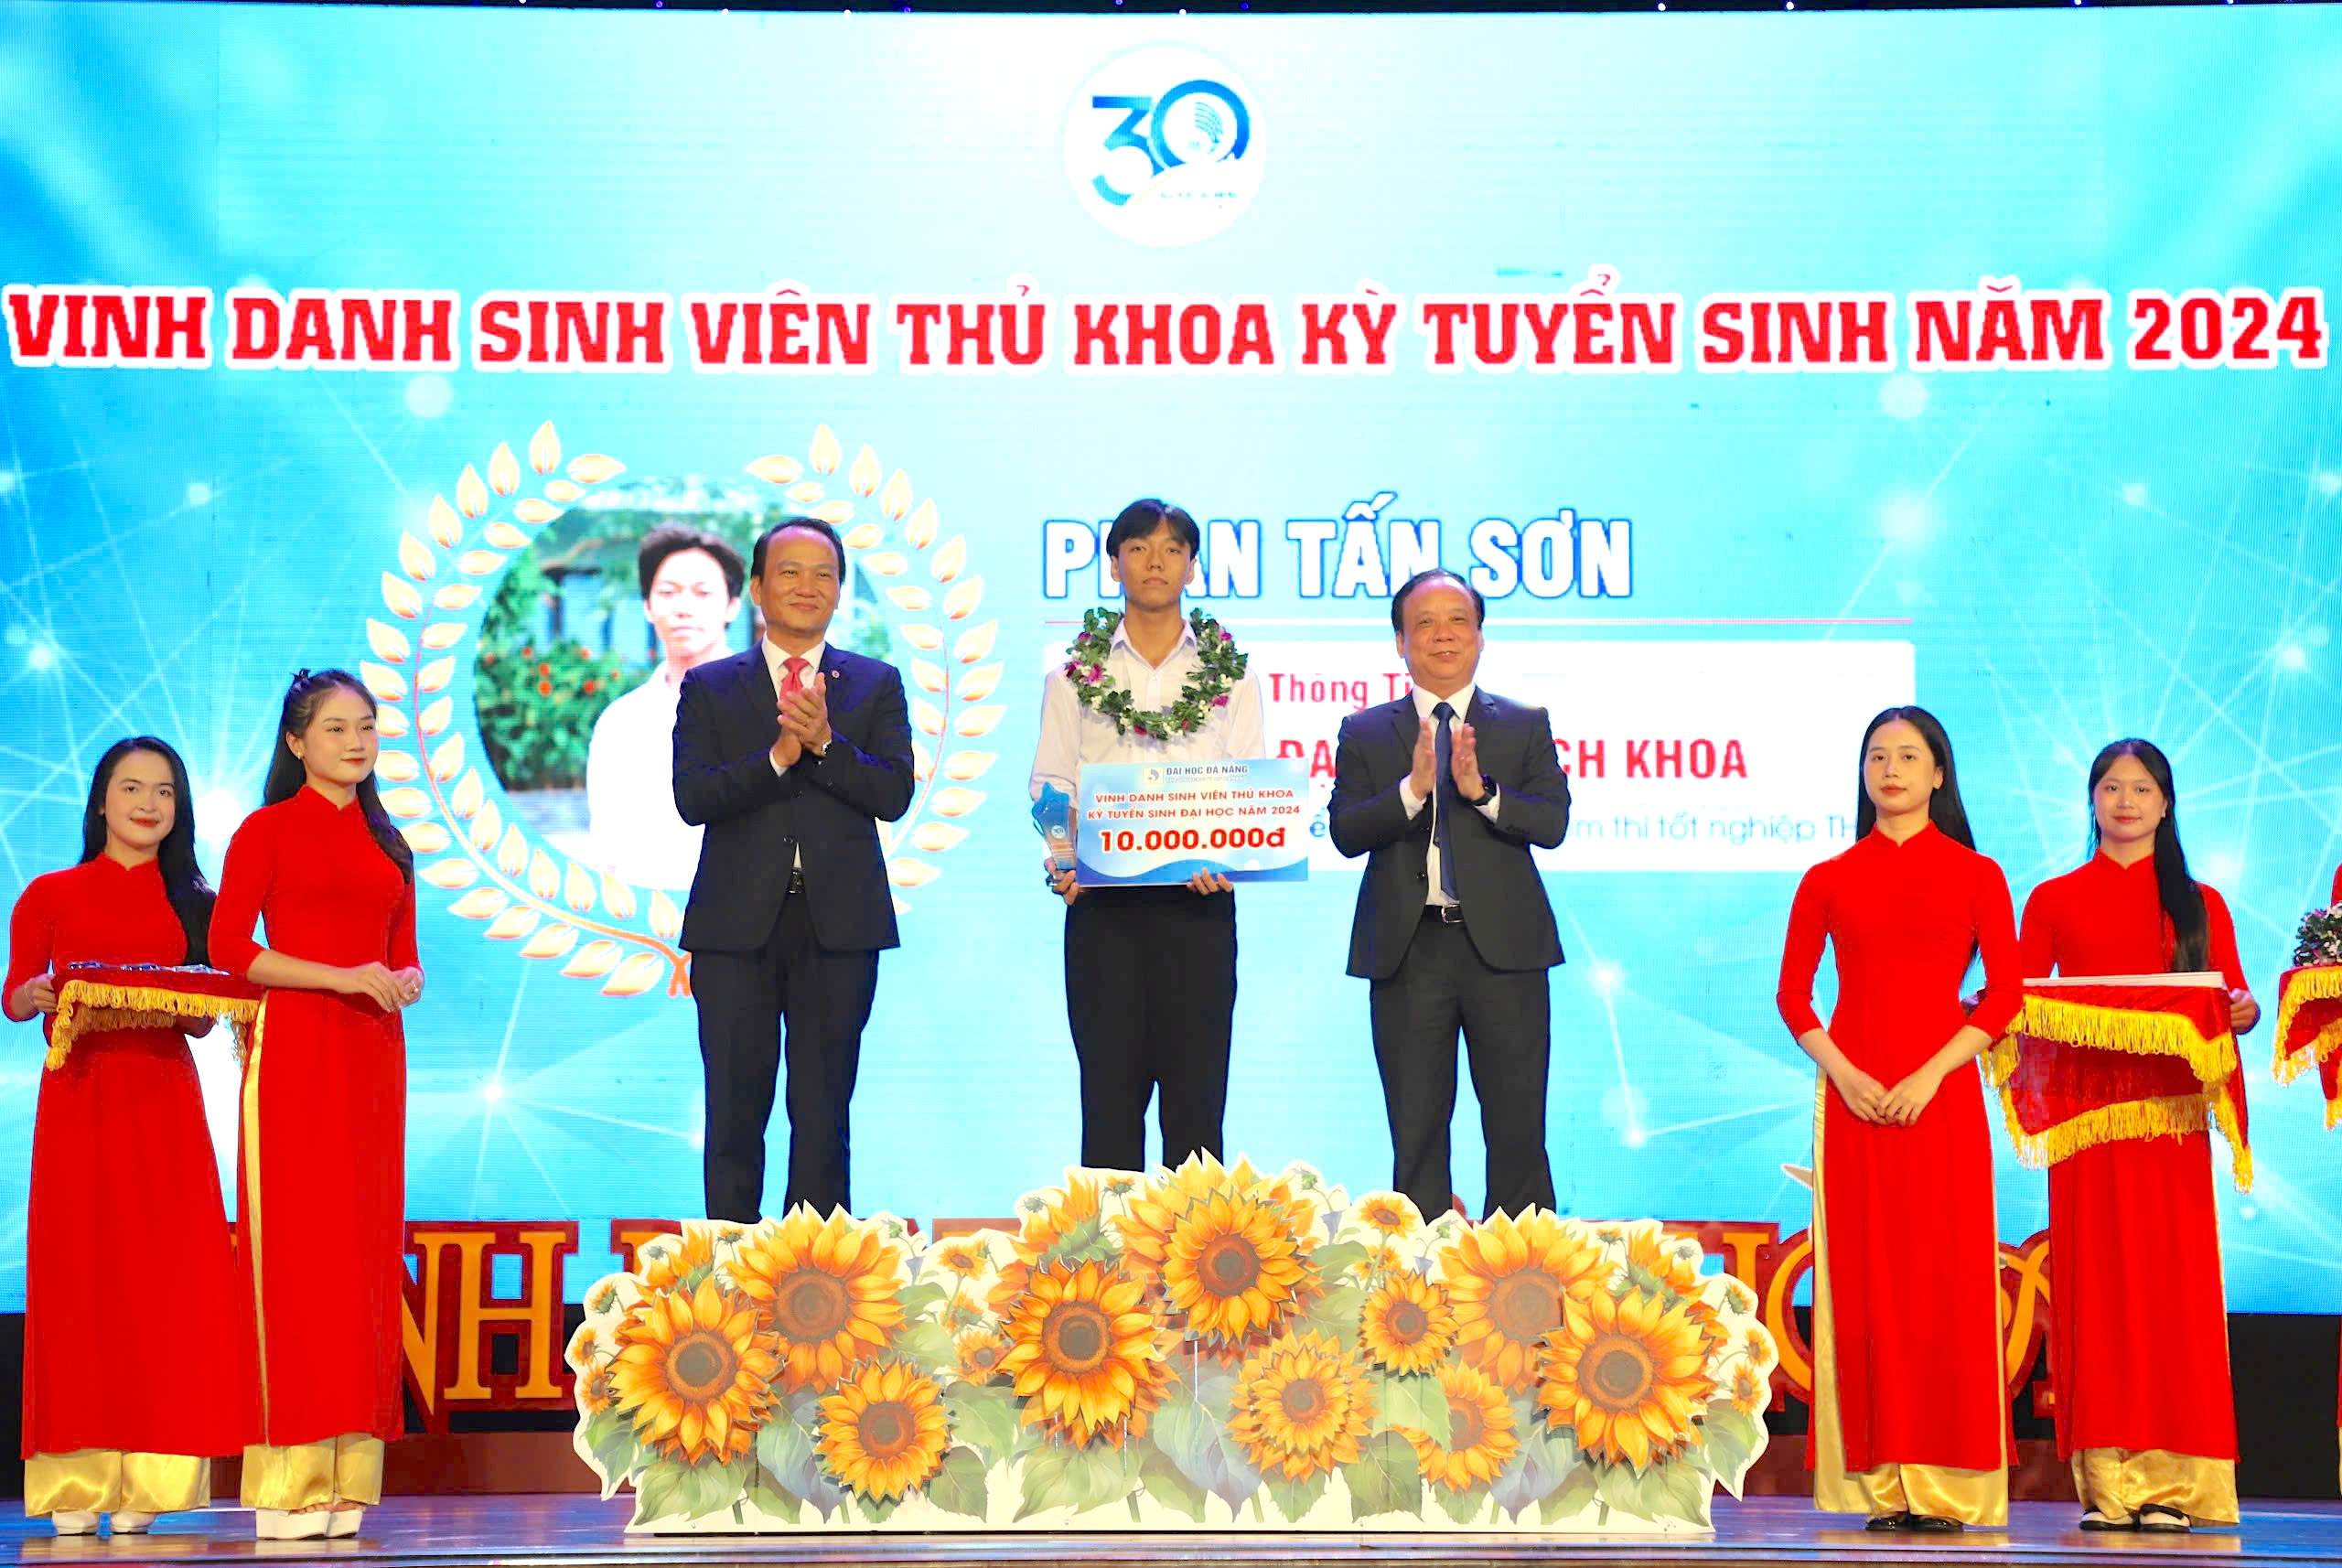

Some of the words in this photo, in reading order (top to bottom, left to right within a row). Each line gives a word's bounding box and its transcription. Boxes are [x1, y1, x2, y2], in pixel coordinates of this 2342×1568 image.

[9, 294, 206, 360] VINH
[231, 297, 452, 361] DANH
[480, 300, 664, 364] SINH
[691, 288, 871, 365] VIÊN
[897, 285, 1046, 365] THỦ
[1074, 304, 1274, 365] KHOA
[1302, 289, 1397, 365] KỲ
[1423, 274, 1675, 365] TUYỂN
[1703, 301, 1887, 364] SINH
[1915, 285, 2104, 362] NĂM
[2133, 296, 2322, 360] 2024
[1044, 520, 1261, 599] PN
[1285, 491, 1441, 599] TẤN
[1469, 508, 1632, 600] SƠN
[1268, 672, 1369, 711] Thông
[1382, 672, 1413, 702] Ti
[1626, 738, 1748, 779] KHOA
[1088, 808, 1103, 820] KỲ
[1107, 805, 1144, 819] TUYỂN
[1148, 809, 1176, 818] SINH
[1180, 808, 1201, 820] ĐẠI
[1206, 807, 1234, 819] HỌC
[1239, 804, 1267, 815] NĂM
[1271, 805, 1300, 815] 2024
[1095, 794, 1125, 803] VINH
[1129, 792, 1165, 802] DANH
[1167, 791, 1196, 801] SINH
[1200, 789, 1227, 800] VIÊN
[1231, 787, 1254, 800] THỦ
[1258, 789, 1294, 799] KHOA
[1100, 826, 1286, 852] 10.000.000đ
[1613, 814, 1649, 840] thi
[1658, 811, 1698, 841] tốt
[1709, 813, 1816, 847] nghiệp
[1824, 814, 1857, 840] TH
[402, 1230, 567, 1416] NH
